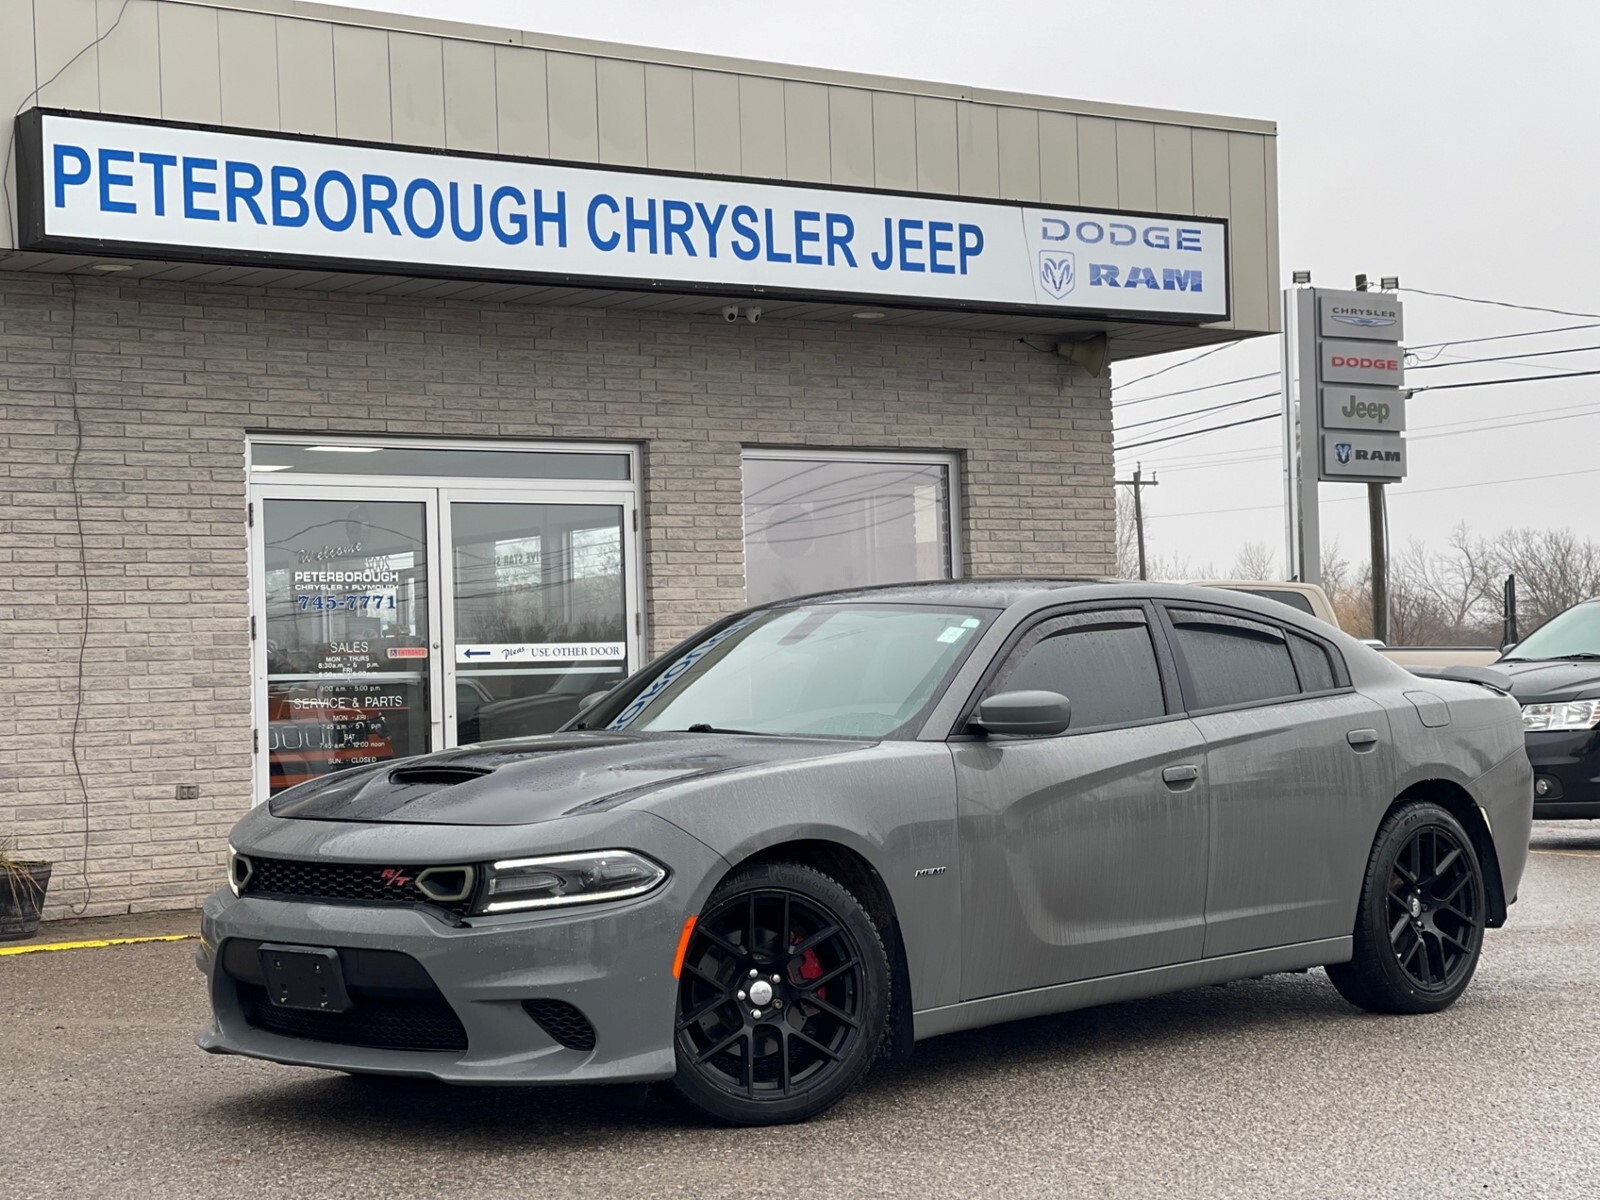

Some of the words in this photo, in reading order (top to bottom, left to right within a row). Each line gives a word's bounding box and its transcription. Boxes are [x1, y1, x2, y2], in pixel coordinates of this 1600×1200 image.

[53, 144, 568, 248] PETERBOROUGH
[587, 193, 857, 269] CHRYSLER
[872, 217, 985, 276] JEEP
[1041, 217, 1202, 252] DODGE
[1088, 263, 1203, 293] RAM
[1332, 306, 1396, 318] CHRYSLER
[1331, 356, 1398, 371] DODGE
[1341, 395, 1390, 424] Jeep
[1355, 449, 1401, 463] RAM
[297, 542, 362, 564] Welcome
[294, 571, 399, 583] PETERBOROUGH
[298, 595, 397, 610] 745-7771
[330, 641, 369, 653] SALES
[553, 648, 588, 657] OTHER
[590, 646, 620, 656] DOOR
[294, 697, 346, 710] SERVICE
[352, 697, 360, 708] &
[365, 696, 403, 708] PARTS
[351, 756, 377, 764] CLOSED
[381, 868, 410, 887] R/T
